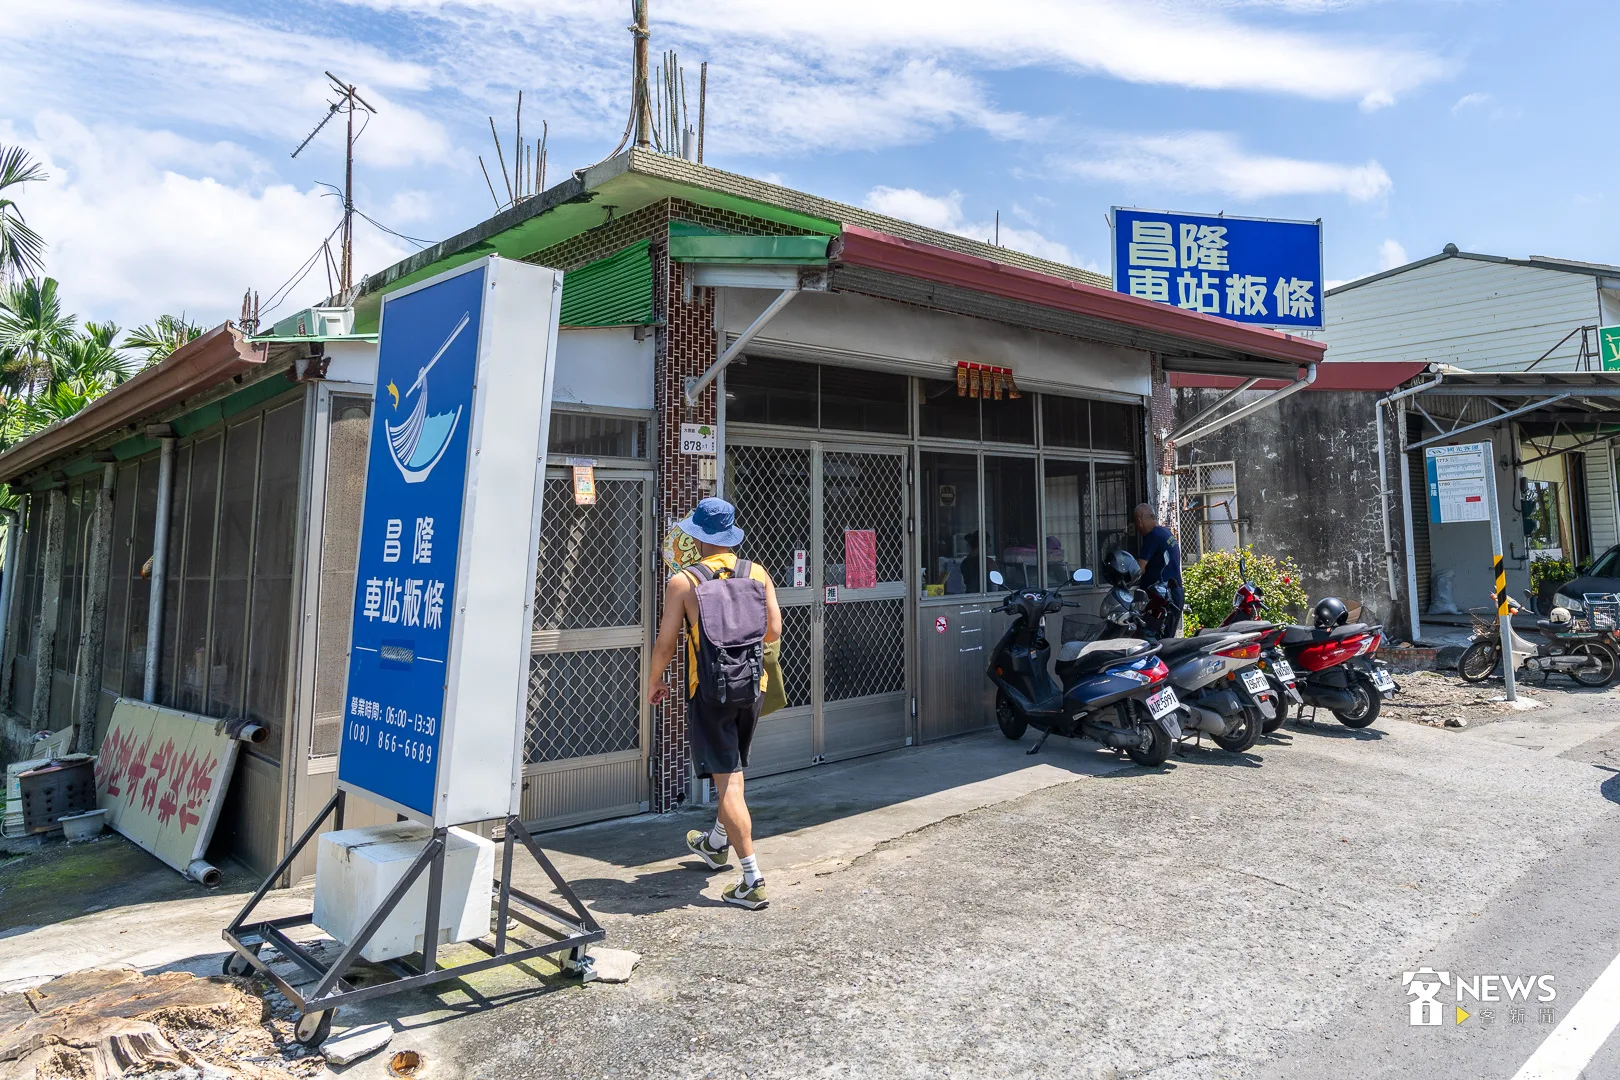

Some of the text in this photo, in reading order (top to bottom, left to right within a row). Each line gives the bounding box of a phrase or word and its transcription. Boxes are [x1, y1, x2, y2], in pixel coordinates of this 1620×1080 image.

[1128, 220, 1230, 271] 昌隆
[383, 516, 434, 565] 昌隆
[827, 587, 837, 598] 推
[1149, 692, 1178, 714] NJE-5991
[349, 720, 432, 764] (08) 866-6689
